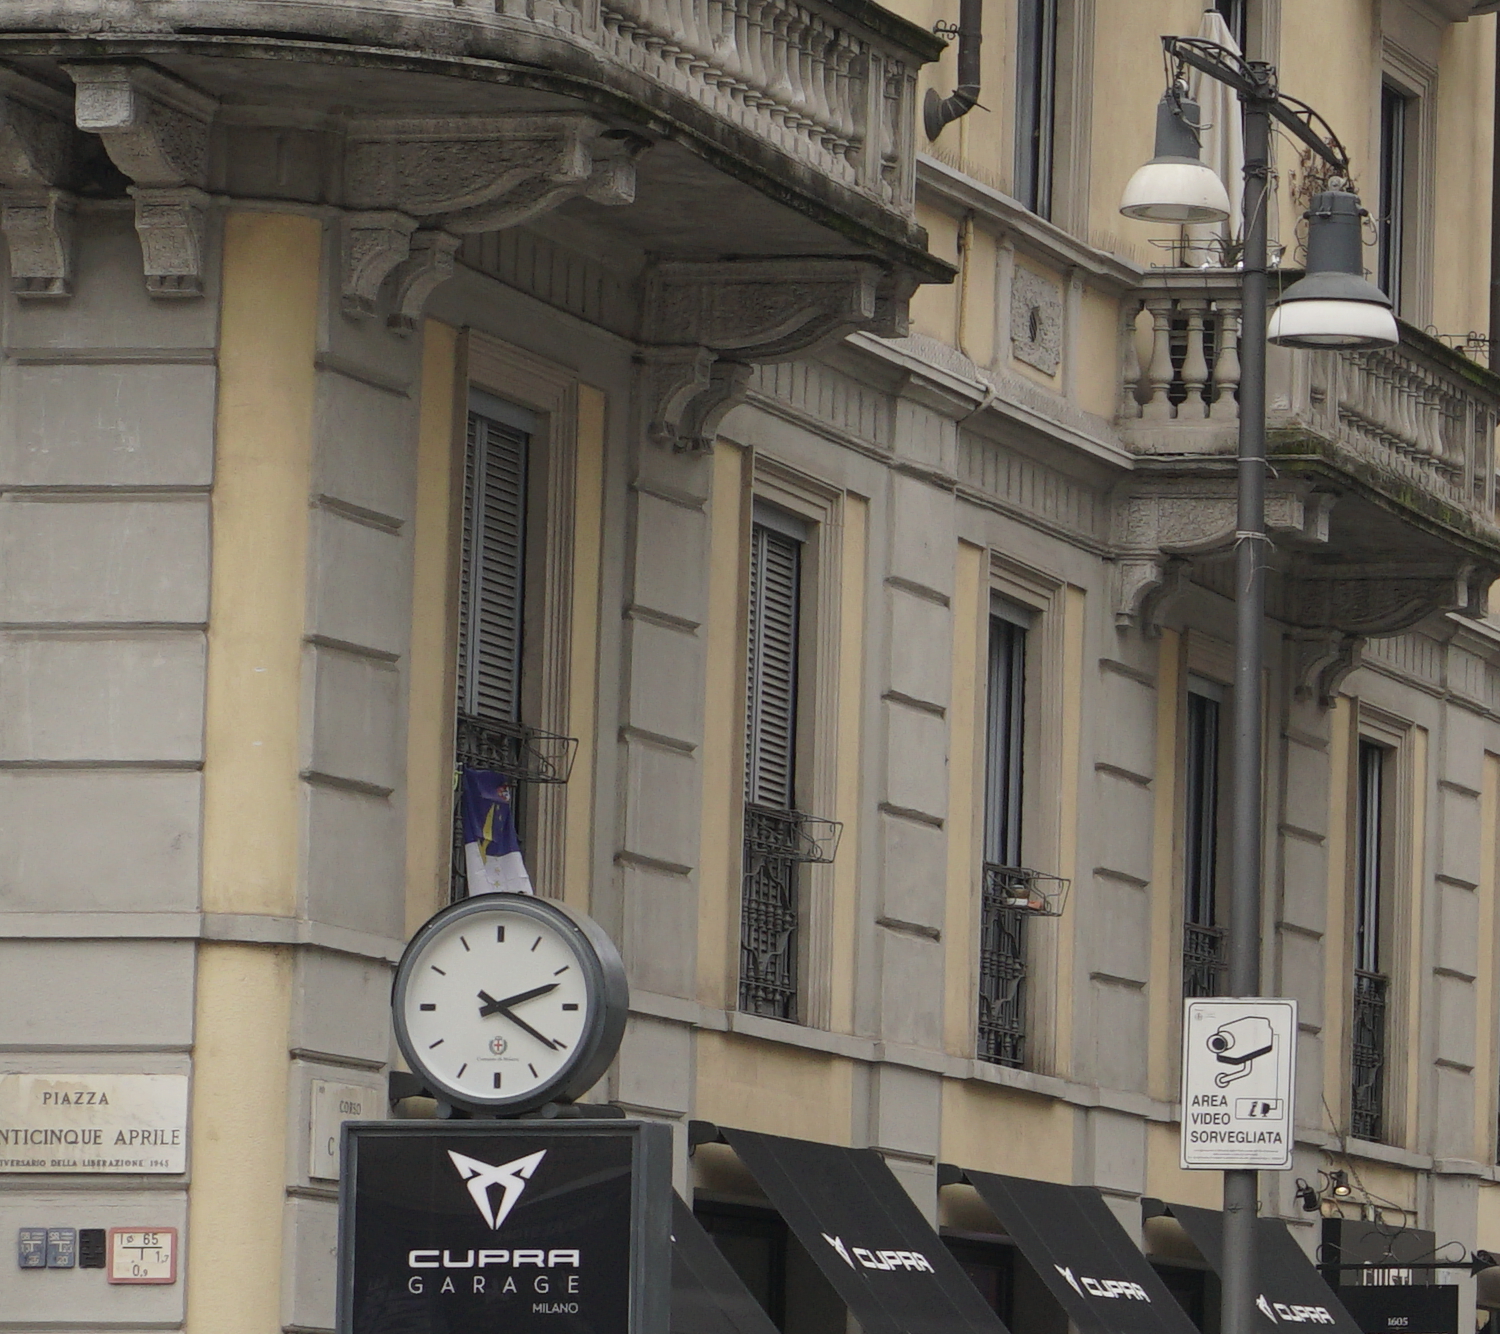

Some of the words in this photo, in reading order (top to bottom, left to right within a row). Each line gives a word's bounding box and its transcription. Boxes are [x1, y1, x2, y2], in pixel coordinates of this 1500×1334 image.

[42, 1091, 110, 1105] PIAZZA
[1191, 1094, 1228, 1107] AREA
[338, 1099, 362, 1116] CORSO
[1191, 1112, 1231, 1125] VIDEO
[113, 1129, 181, 1146] APRILE
[1189, 1130, 1283, 1144] SORVEGLIATA
[51, 1159, 78, 1168] DELLA
[82, 1159, 144, 1168] LIBERAZIONE
[150, 1159, 169, 1168] 1945
[143, 1233, 159, 1246] 65
[408, 1249, 580, 1268] CUPRA
[851, 1246, 936, 1274] CUPRA
[408, 1275, 580, 1294] GARAGE
[1080, 1276, 1152, 1303] CUPRA
[532, 1302, 579, 1314] MILANO
[1272, 1302, 1336, 1325] CUPRA
[1387, 1317, 1408, 1326] 1605
